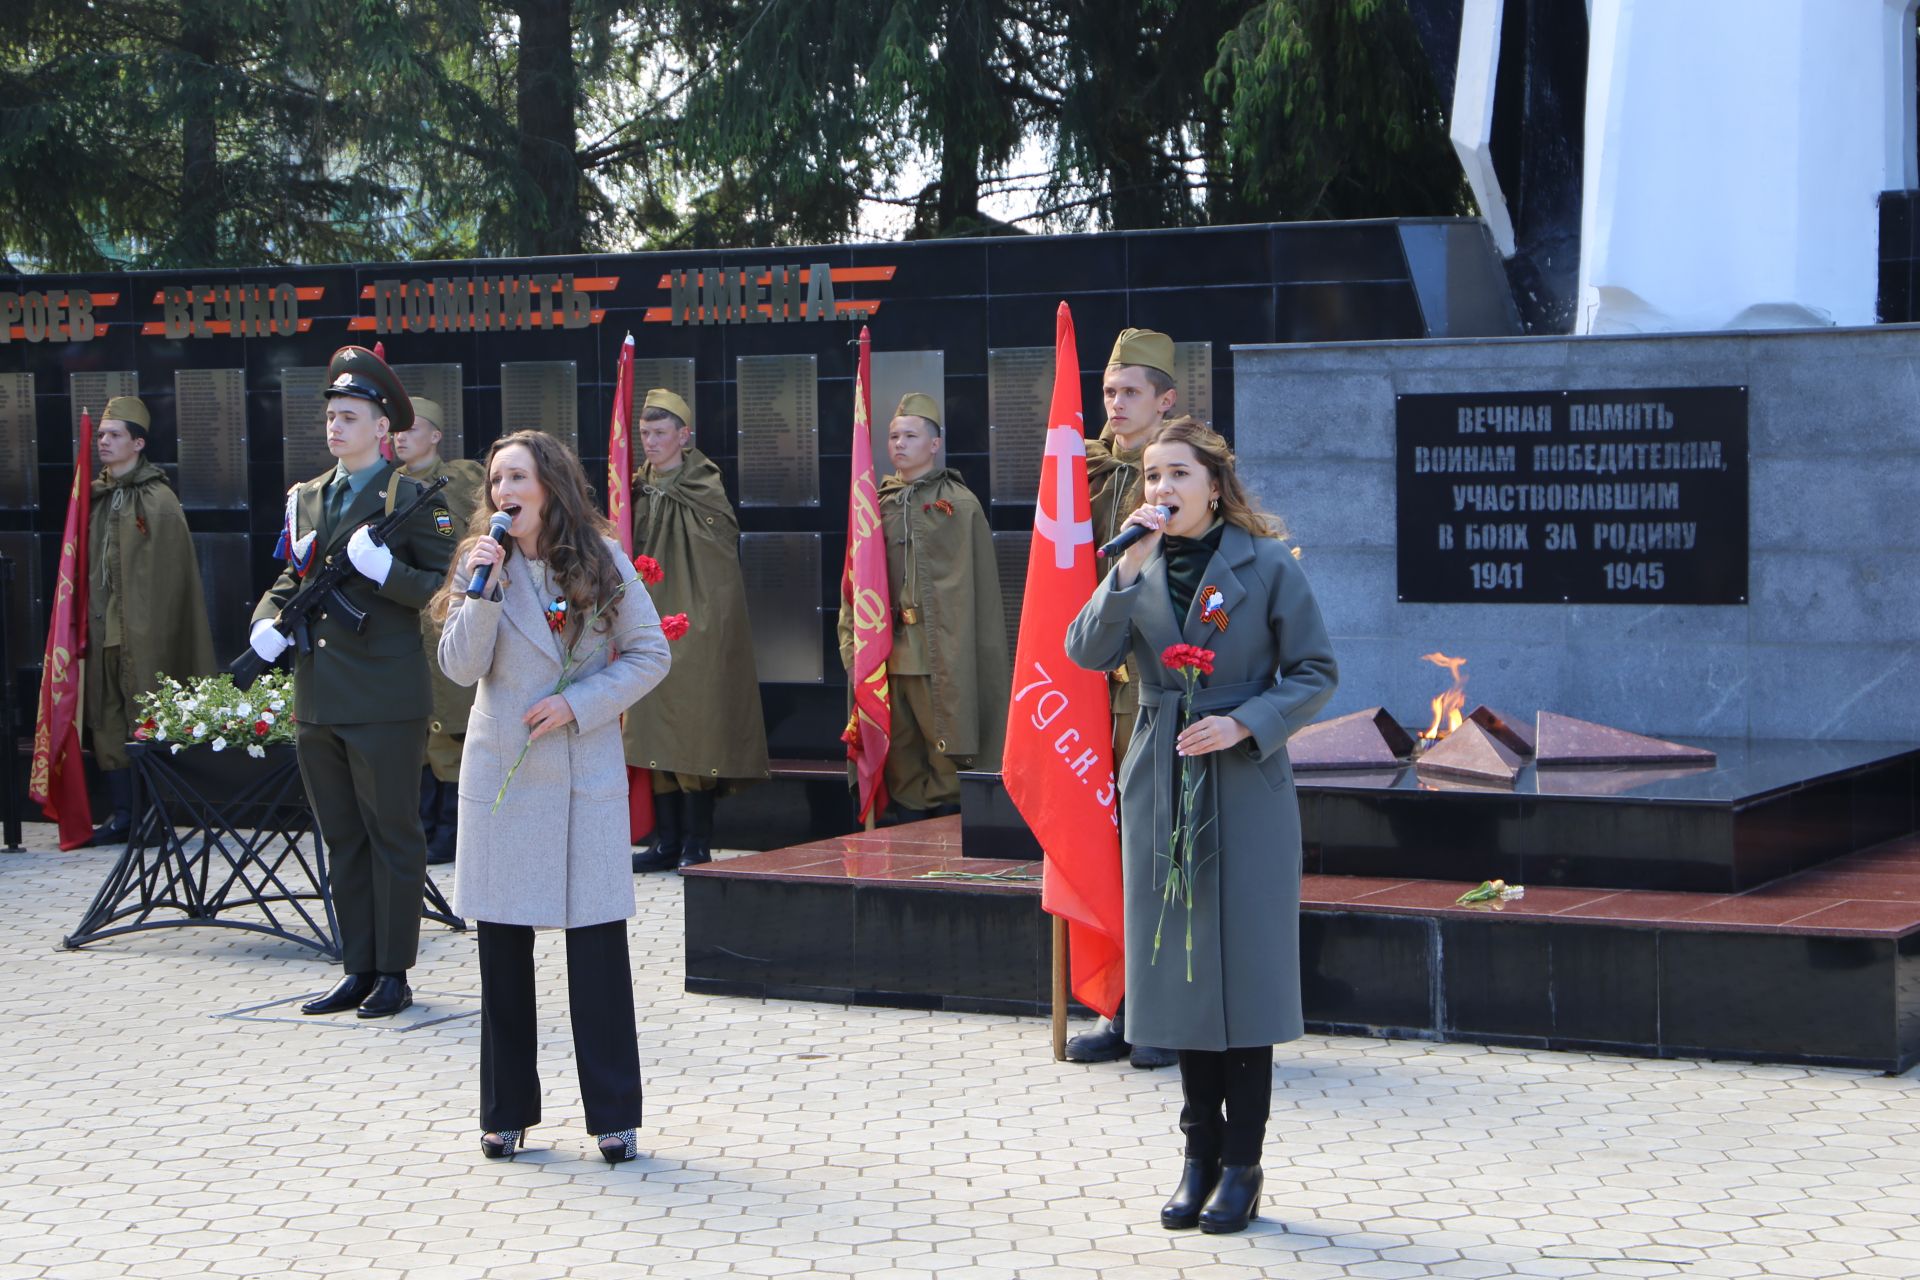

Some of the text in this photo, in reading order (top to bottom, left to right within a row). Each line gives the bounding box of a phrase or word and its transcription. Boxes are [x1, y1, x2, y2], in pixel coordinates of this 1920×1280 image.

[163, 283, 298, 339] ВЕЧНО
[374, 273, 591, 334] ПОМНИТЬ
[671, 263, 868, 326] ИМЕНА...
[1458, 403, 1674, 433] ВЕЧНАЯ ПАМЯТЬ
[1415, 441, 1728, 475] ВОИНАМ ПОБЕДИТЕЛЯМ,
[1453, 483, 1680, 512] УЧАСТВОВАВШИМ
[1438, 522, 1697, 553] В БОЯХ ЗА РОДИНУ
[1470, 562, 1665, 590] 1941 1945
[1015, 661, 1069, 730] 79
